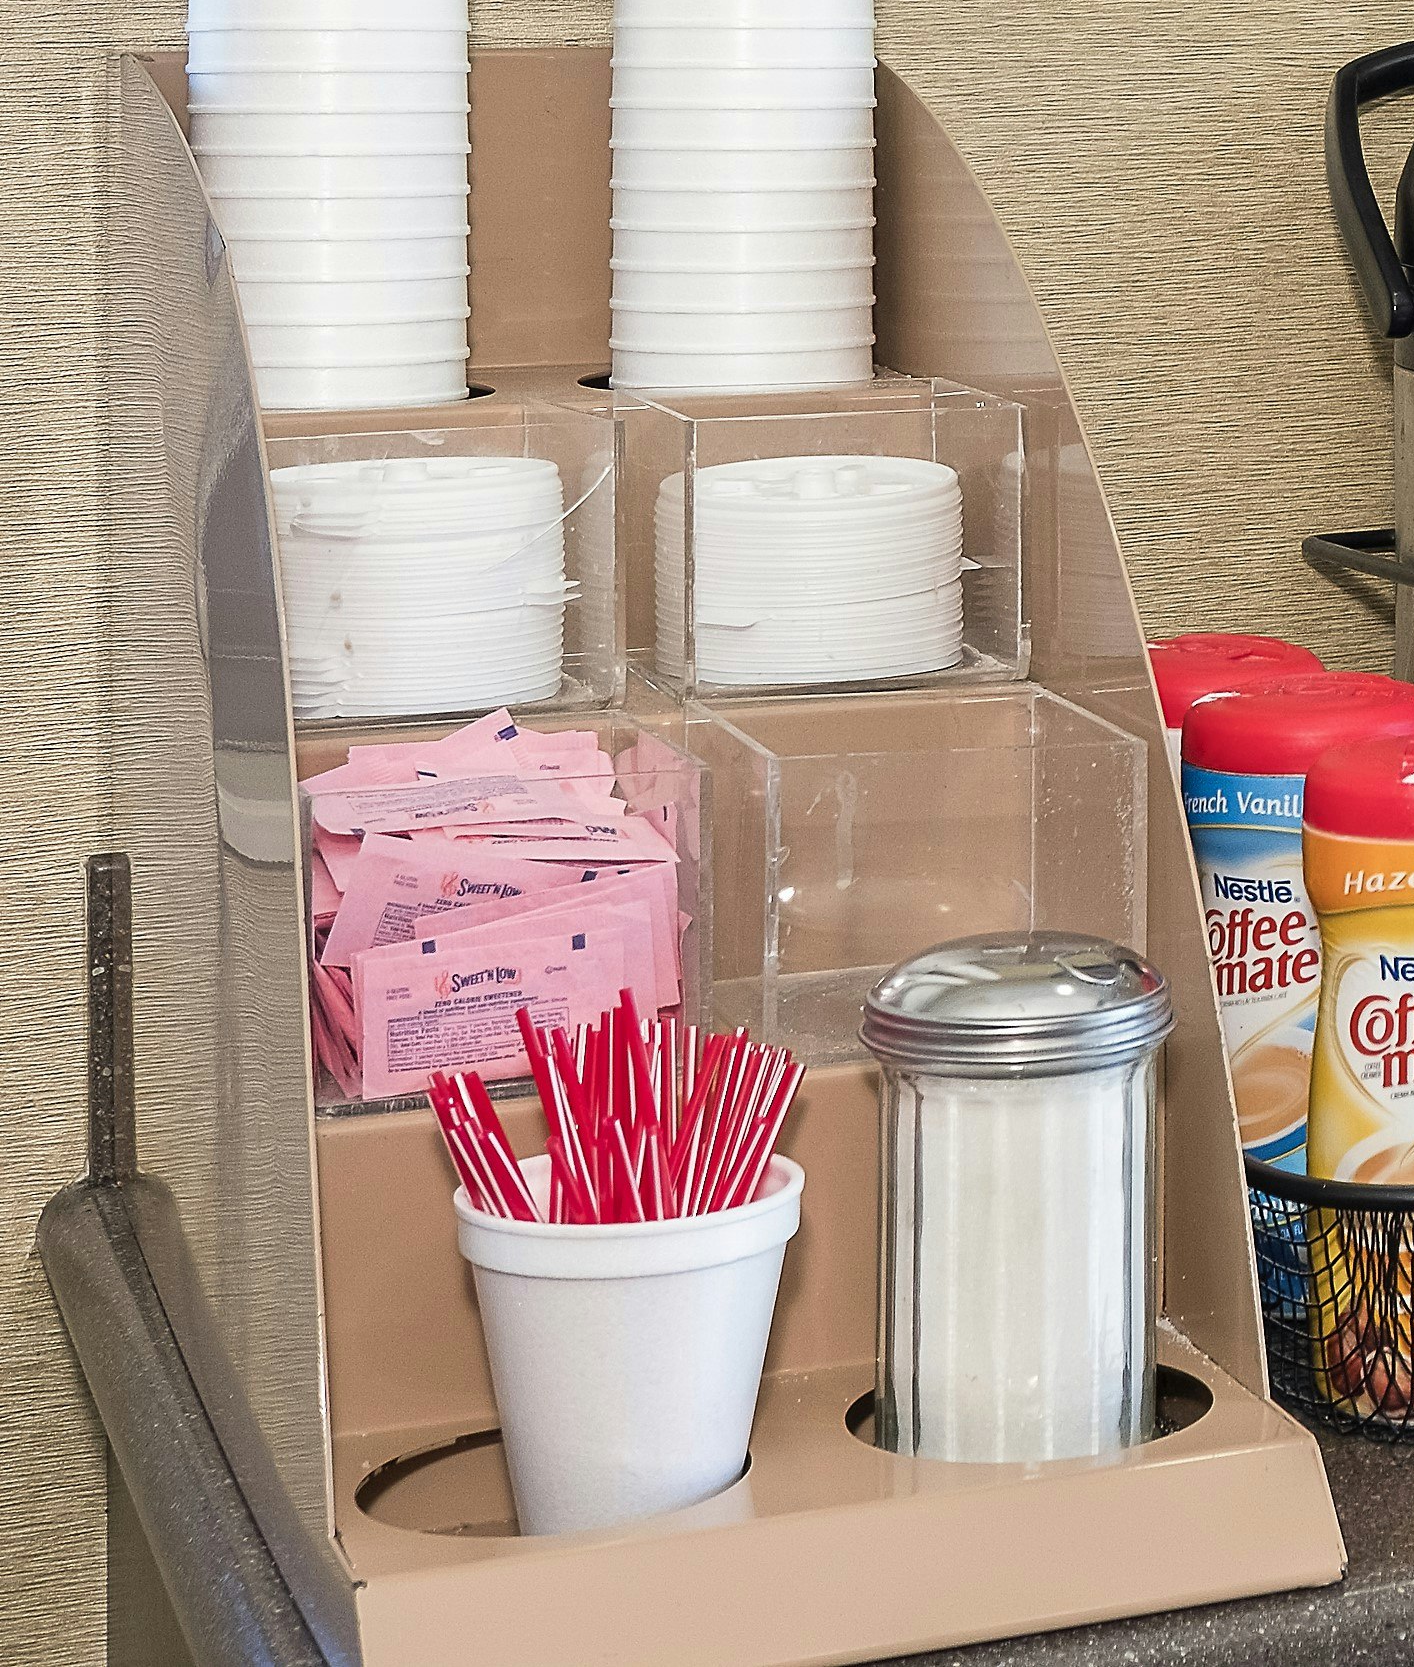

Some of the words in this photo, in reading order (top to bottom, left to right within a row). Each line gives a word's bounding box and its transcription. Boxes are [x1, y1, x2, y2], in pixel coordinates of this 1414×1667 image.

[1237, 791, 1301, 818] Vanil
[1214, 873, 1293, 903] Nestlé
[496, 966, 517, 984] LOW
[1214, 948, 1320, 997] mate
